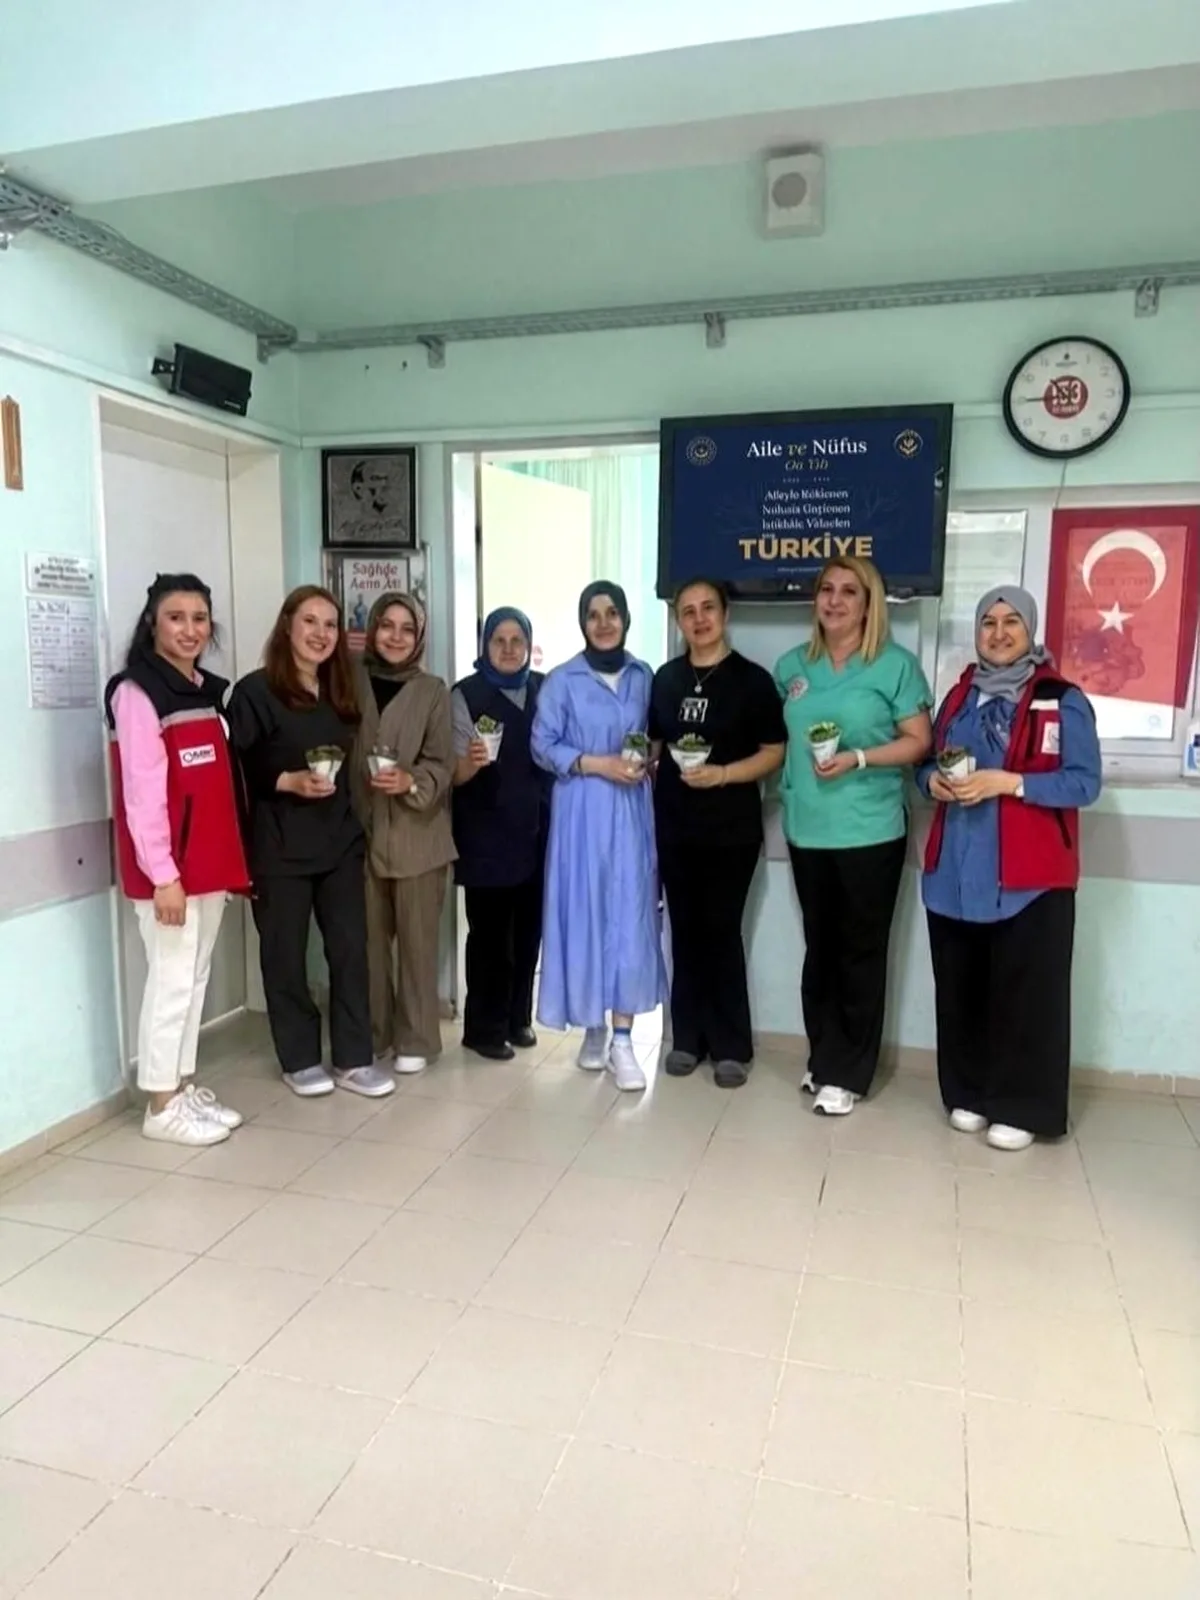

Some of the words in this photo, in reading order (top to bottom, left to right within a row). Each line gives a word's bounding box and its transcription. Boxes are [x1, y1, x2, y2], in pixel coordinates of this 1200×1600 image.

[746, 440, 783, 458] Aile
[787, 442, 807, 457] ve
[812, 437, 868, 456] Nüfus
[738, 532, 873, 561] TÜRKİYE
